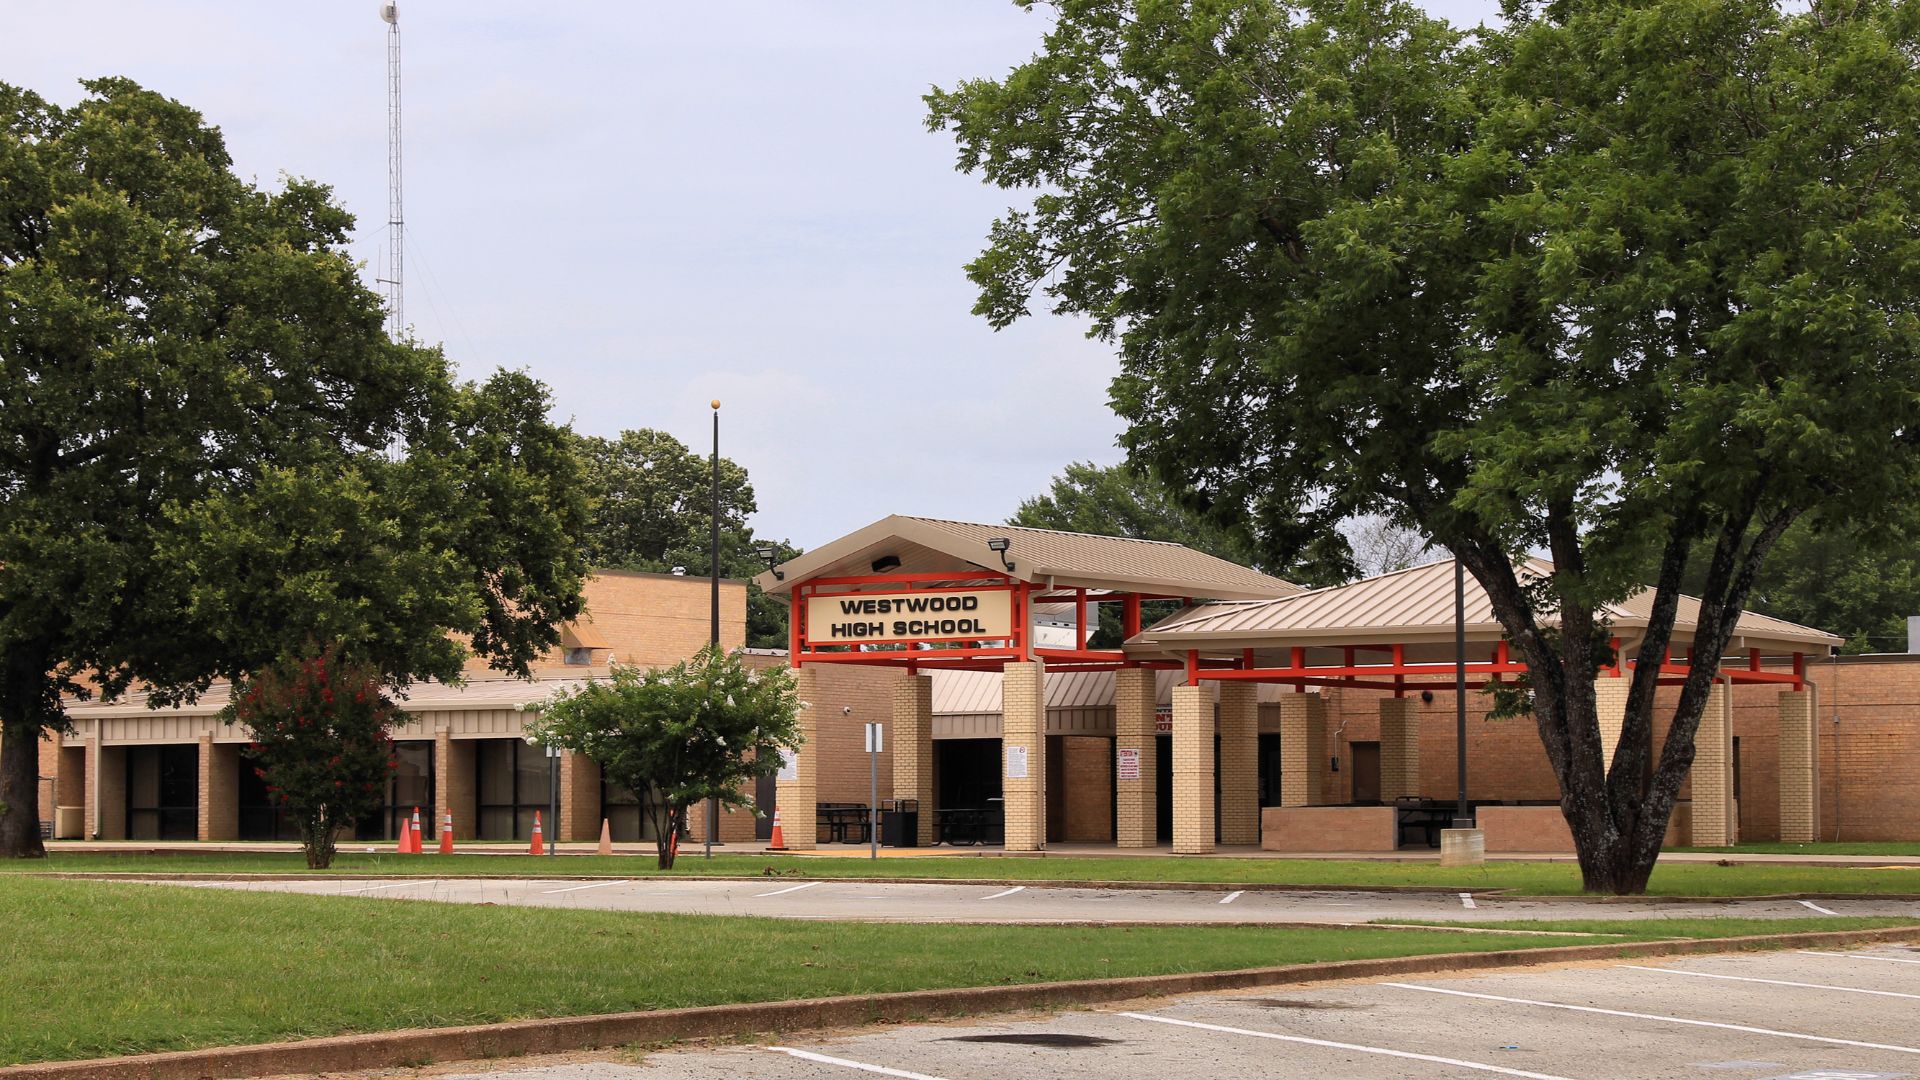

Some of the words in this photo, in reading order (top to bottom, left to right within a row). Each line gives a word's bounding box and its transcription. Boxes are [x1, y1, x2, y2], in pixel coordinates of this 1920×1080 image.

[840, 596, 978, 615] WESTWOOD
[831, 621, 884, 638] HIGH
[893, 618, 986, 636] SCHOOL
